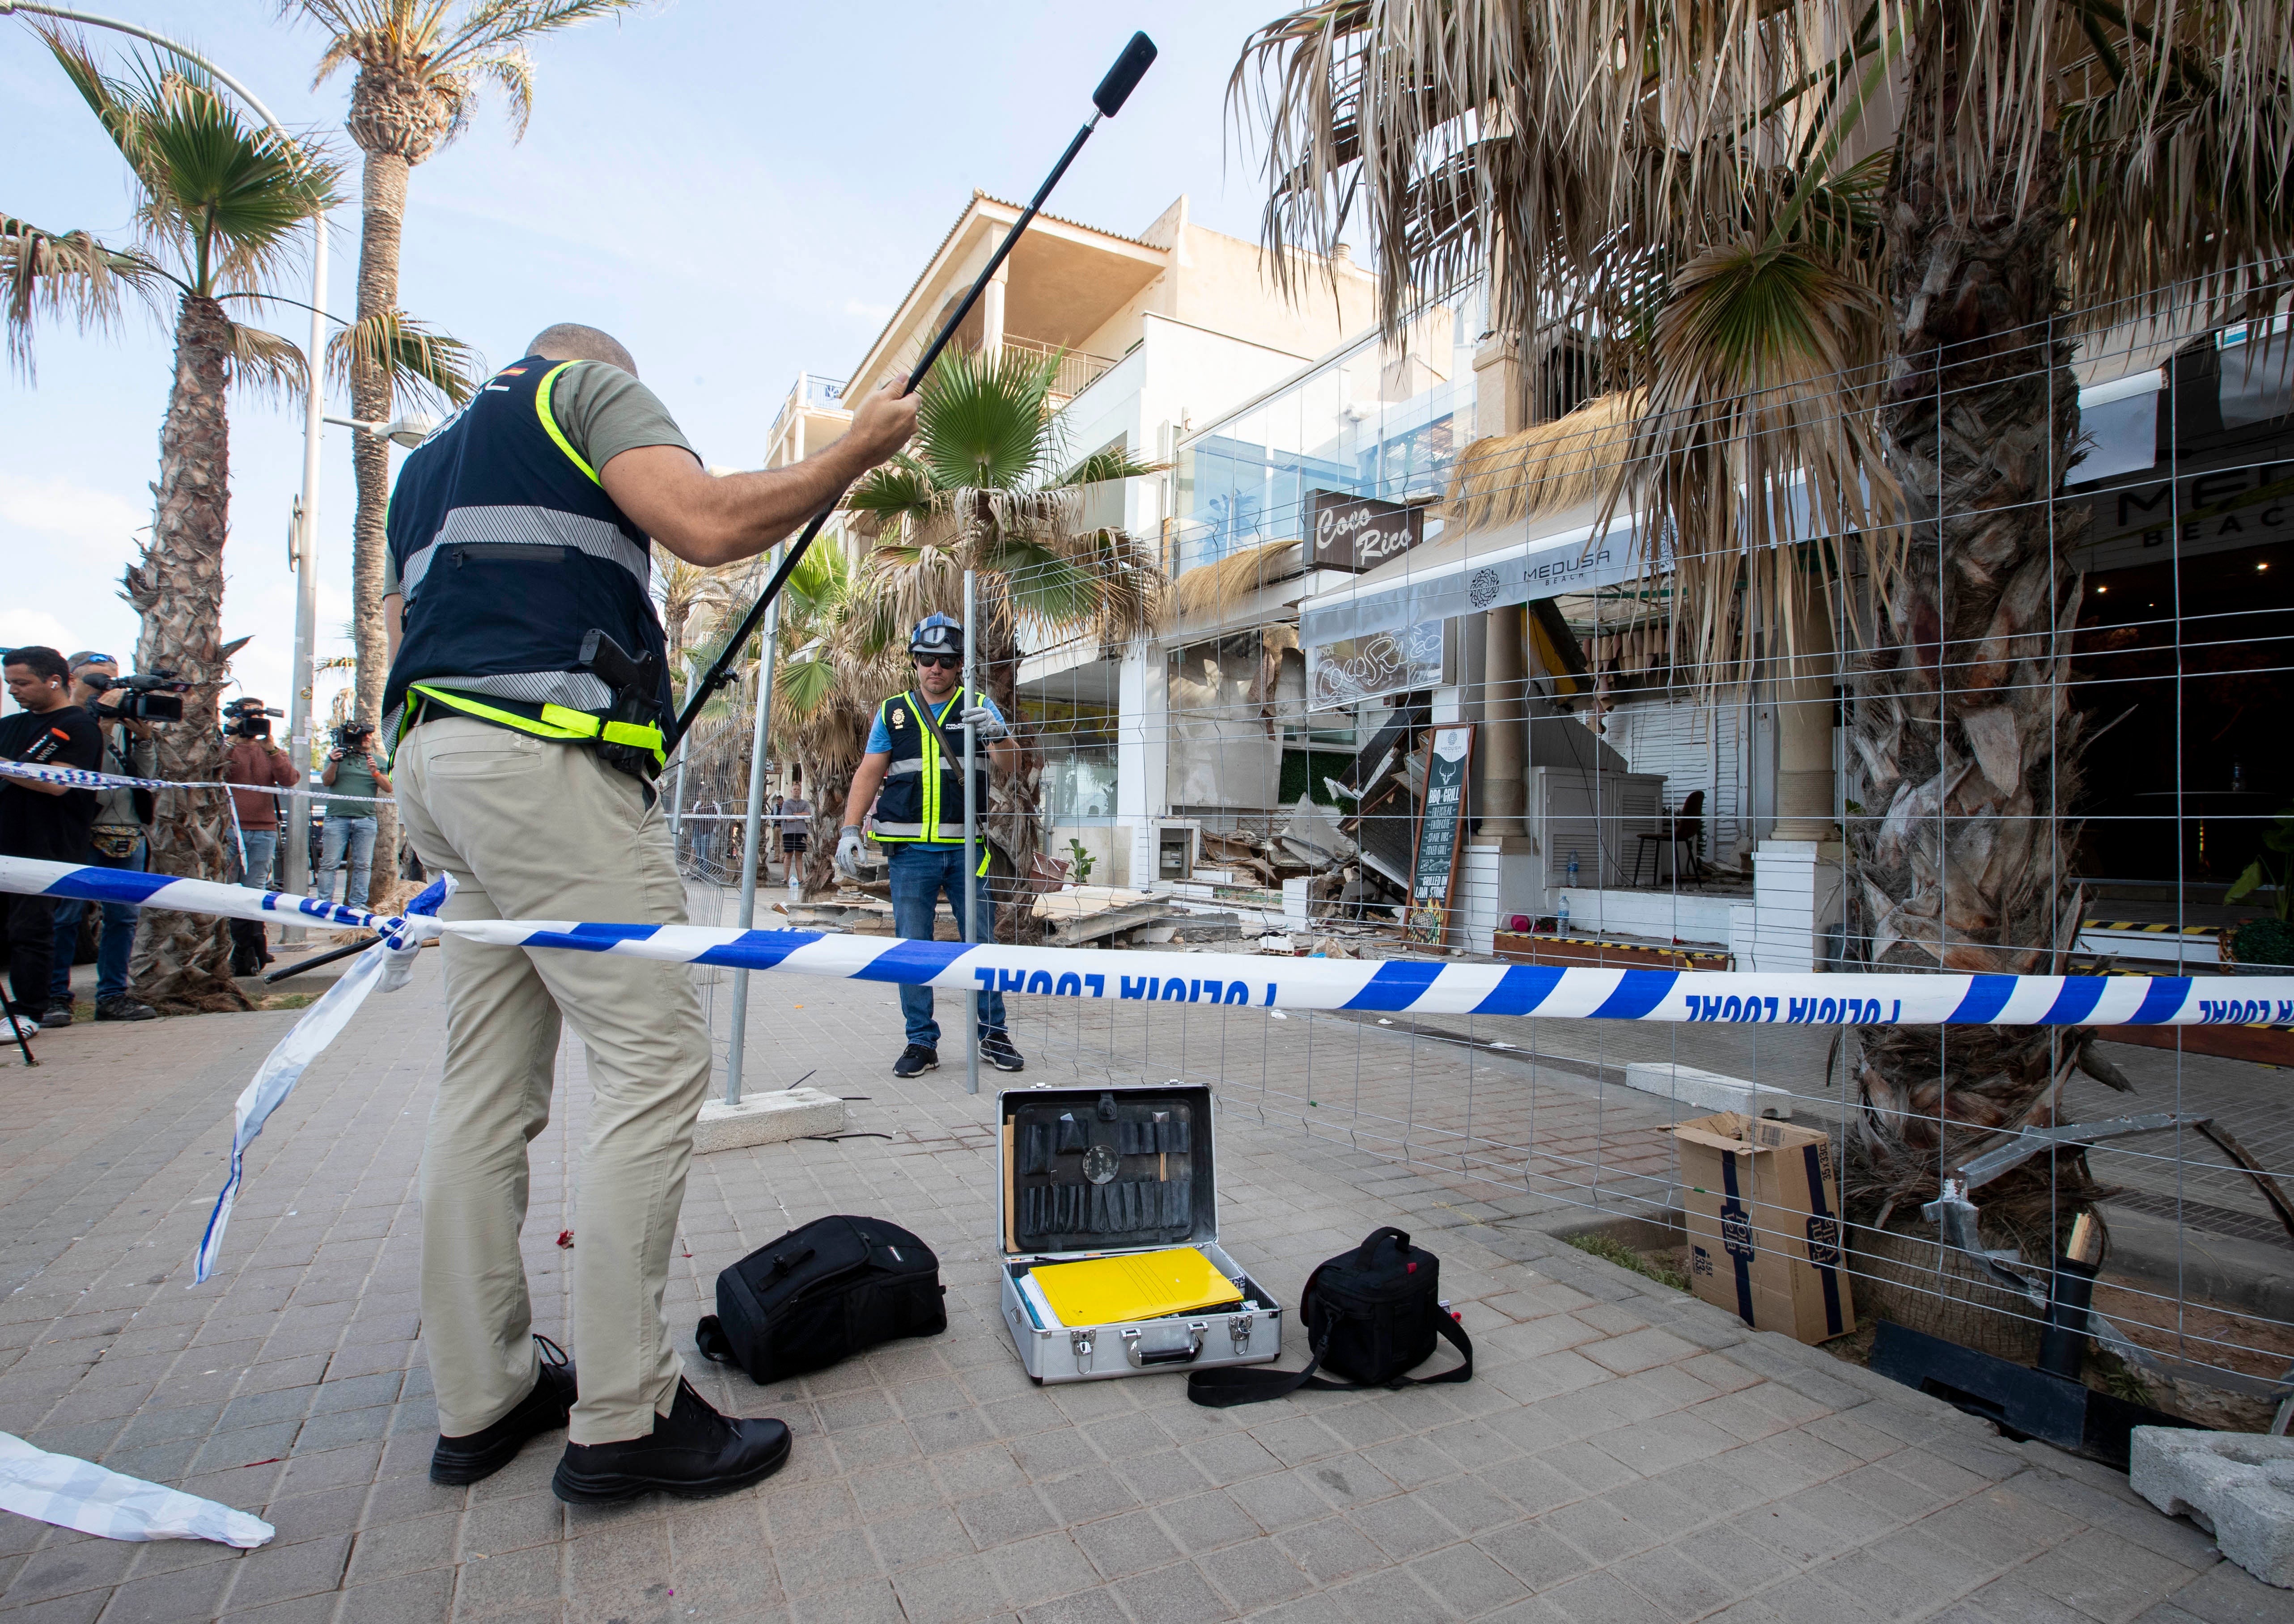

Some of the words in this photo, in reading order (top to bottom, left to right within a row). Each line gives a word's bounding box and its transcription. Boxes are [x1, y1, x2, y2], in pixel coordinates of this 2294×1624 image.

[1316, 508, 1372, 549] Coco
[1356, 529, 1412, 566] Rico
[1524, 550, 1610, 581] MEDUSA
[1545, 573, 1583, 586] BEACH
[1429, 789, 1441, 805] BBQ
[1443, 787, 1459, 803] GRILL
[1432, 806, 1453, 817] FILETSTEAK
[1428, 832, 1440, 842] SPARE
[1441, 832, 1449, 842] RIBS
[1426, 845, 1437, 855] MIXED
[1437, 845, 1447, 855] GRILL
[1420, 861, 1429, 870] AND
[1423, 875, 1441, 886] GRILLED
[1441, 875, 1448, 886] ON
[1415, 886, 1428, 898] LAVA
[1429, 886, 1446, 898] STONE
[1724, 1212, 1738, 1251] Vella
[1735, 1214, 1751, 1256] Font
[1822, 1215, 1837, 1262] Vella
[1811, 1220, 1827, 1262] Font
